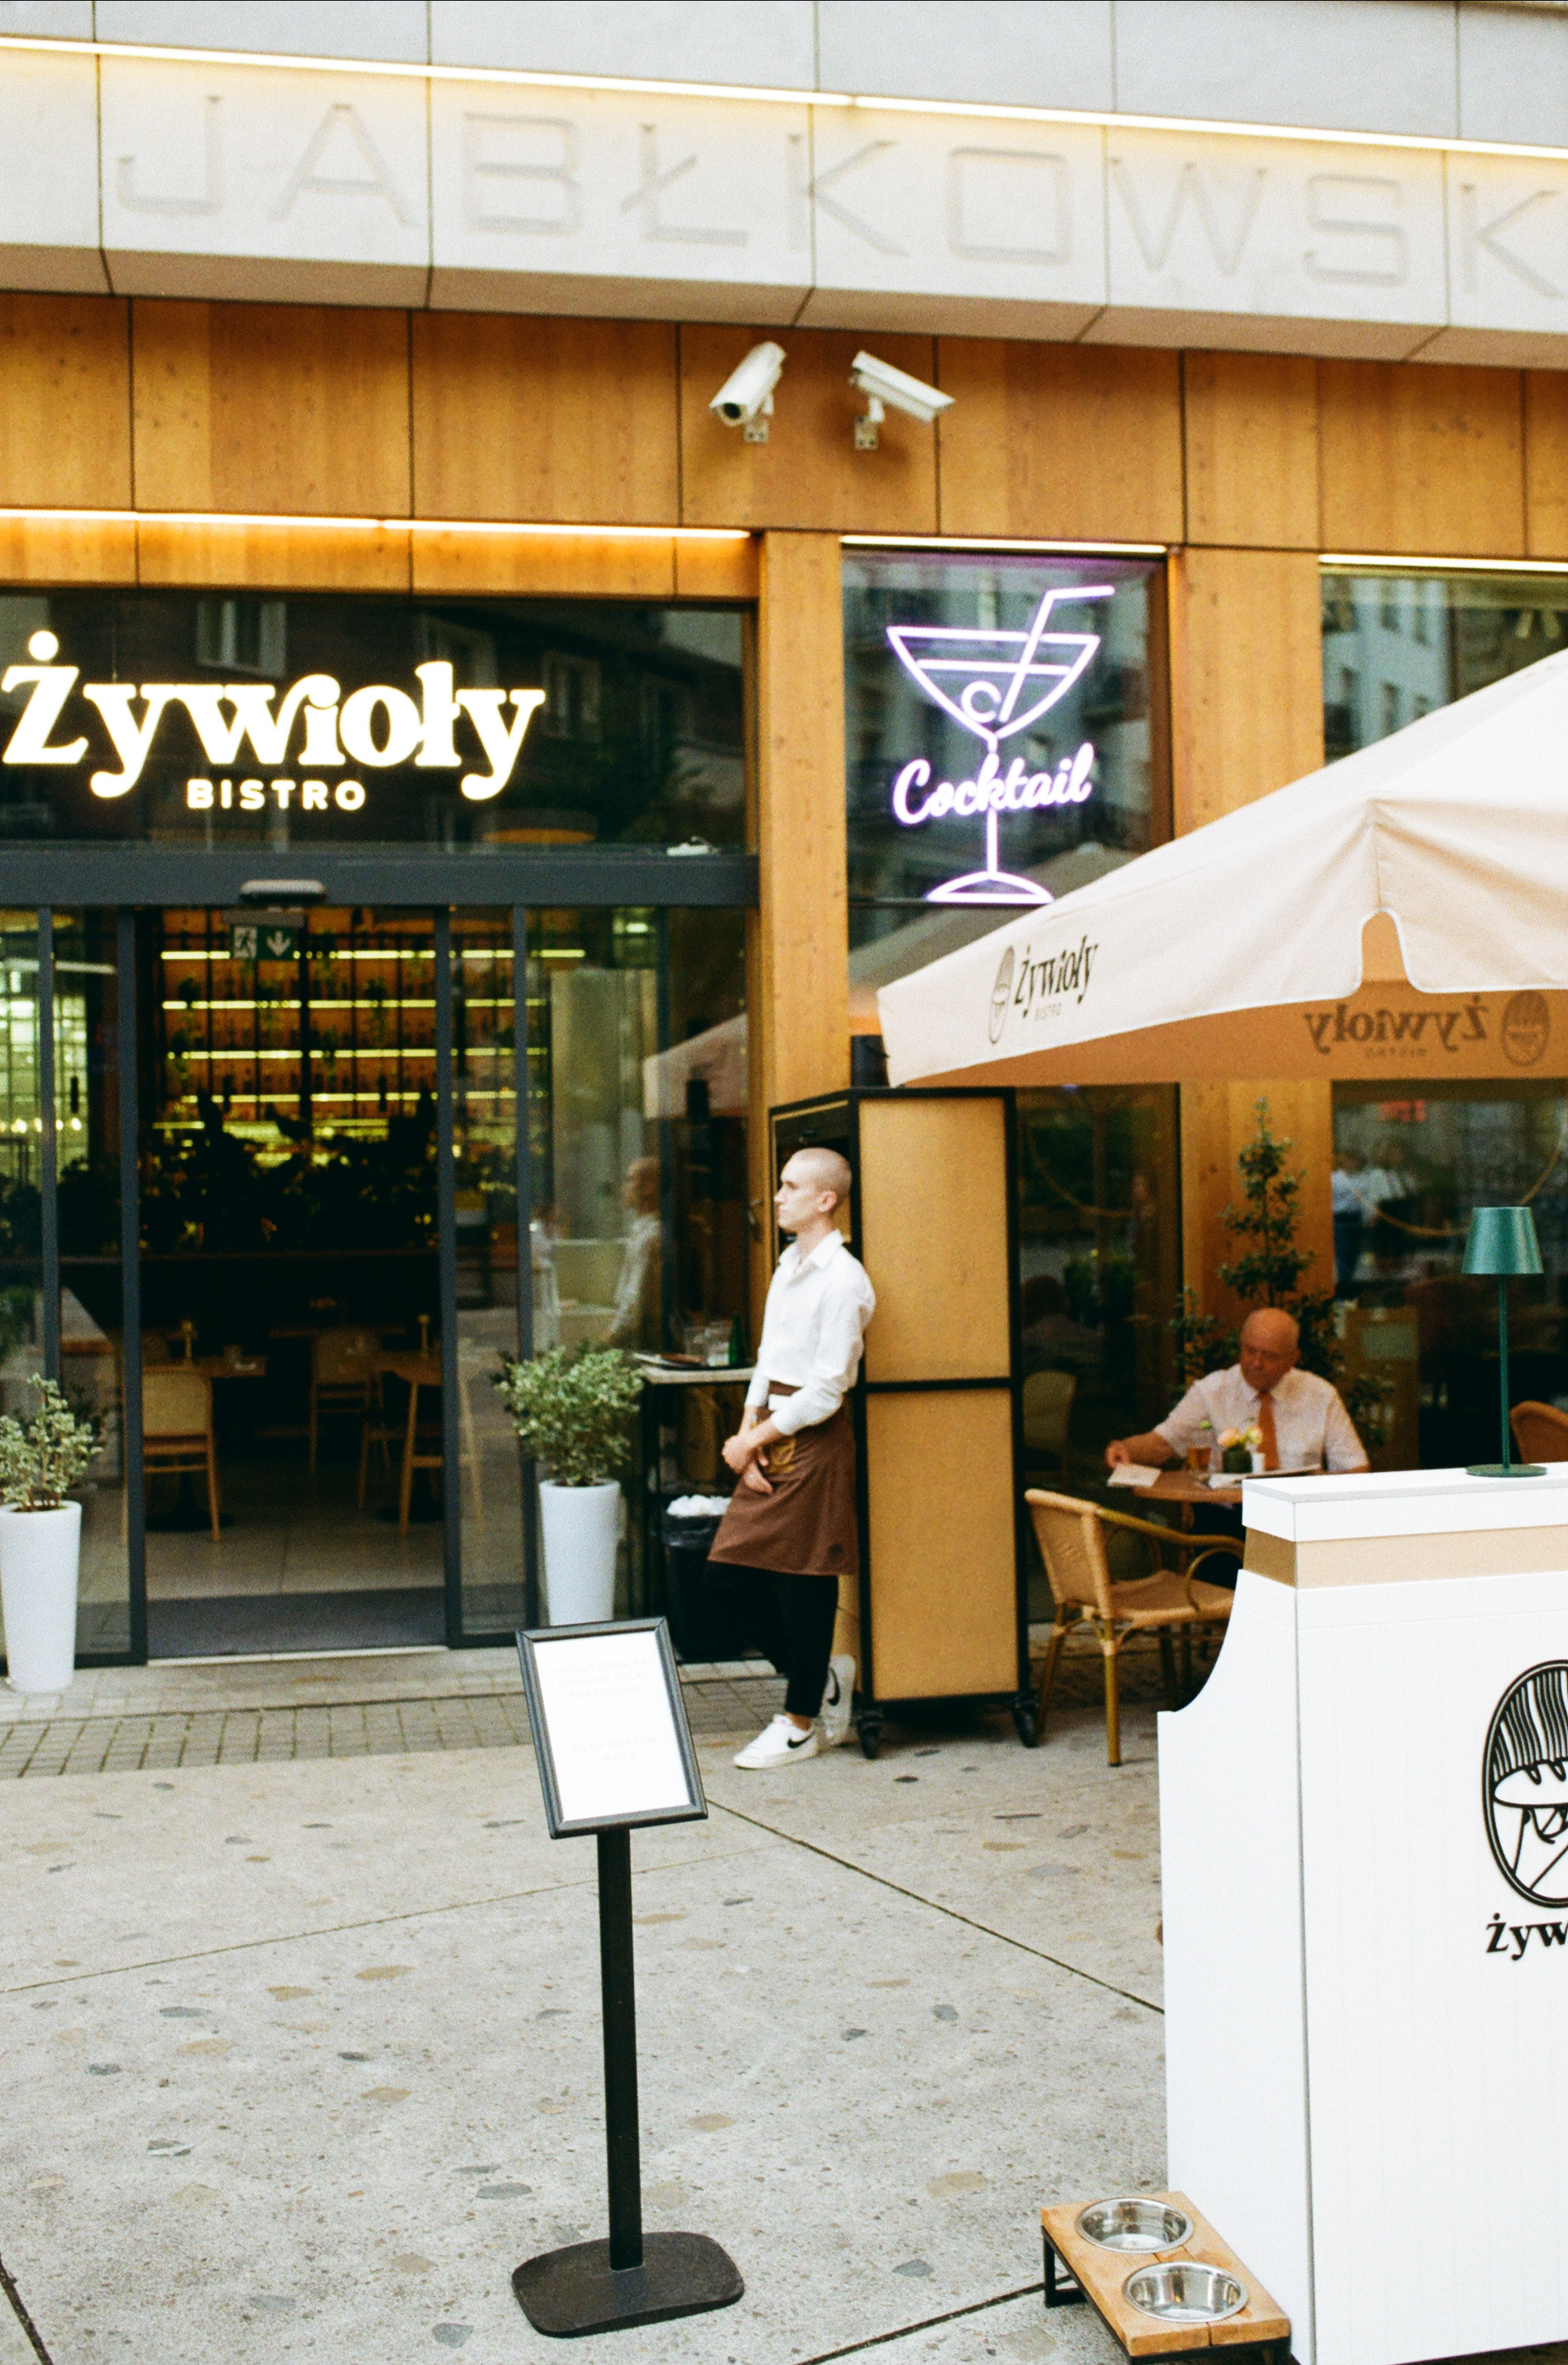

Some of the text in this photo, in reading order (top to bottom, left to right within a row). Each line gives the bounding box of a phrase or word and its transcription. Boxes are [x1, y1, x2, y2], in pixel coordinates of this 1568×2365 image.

[1, 630, 545, 800] Żywioły
[187, 779, 366, 810] BISTRO
[893, 743, 1095, 824] Cocktail
[571, 1741, 604, 1752] PLEASE
[633, 1736, 646, 1745] TO
[646, 1734, 659, 1743] BE
[601, 1750, 635, 1762] SEATED
